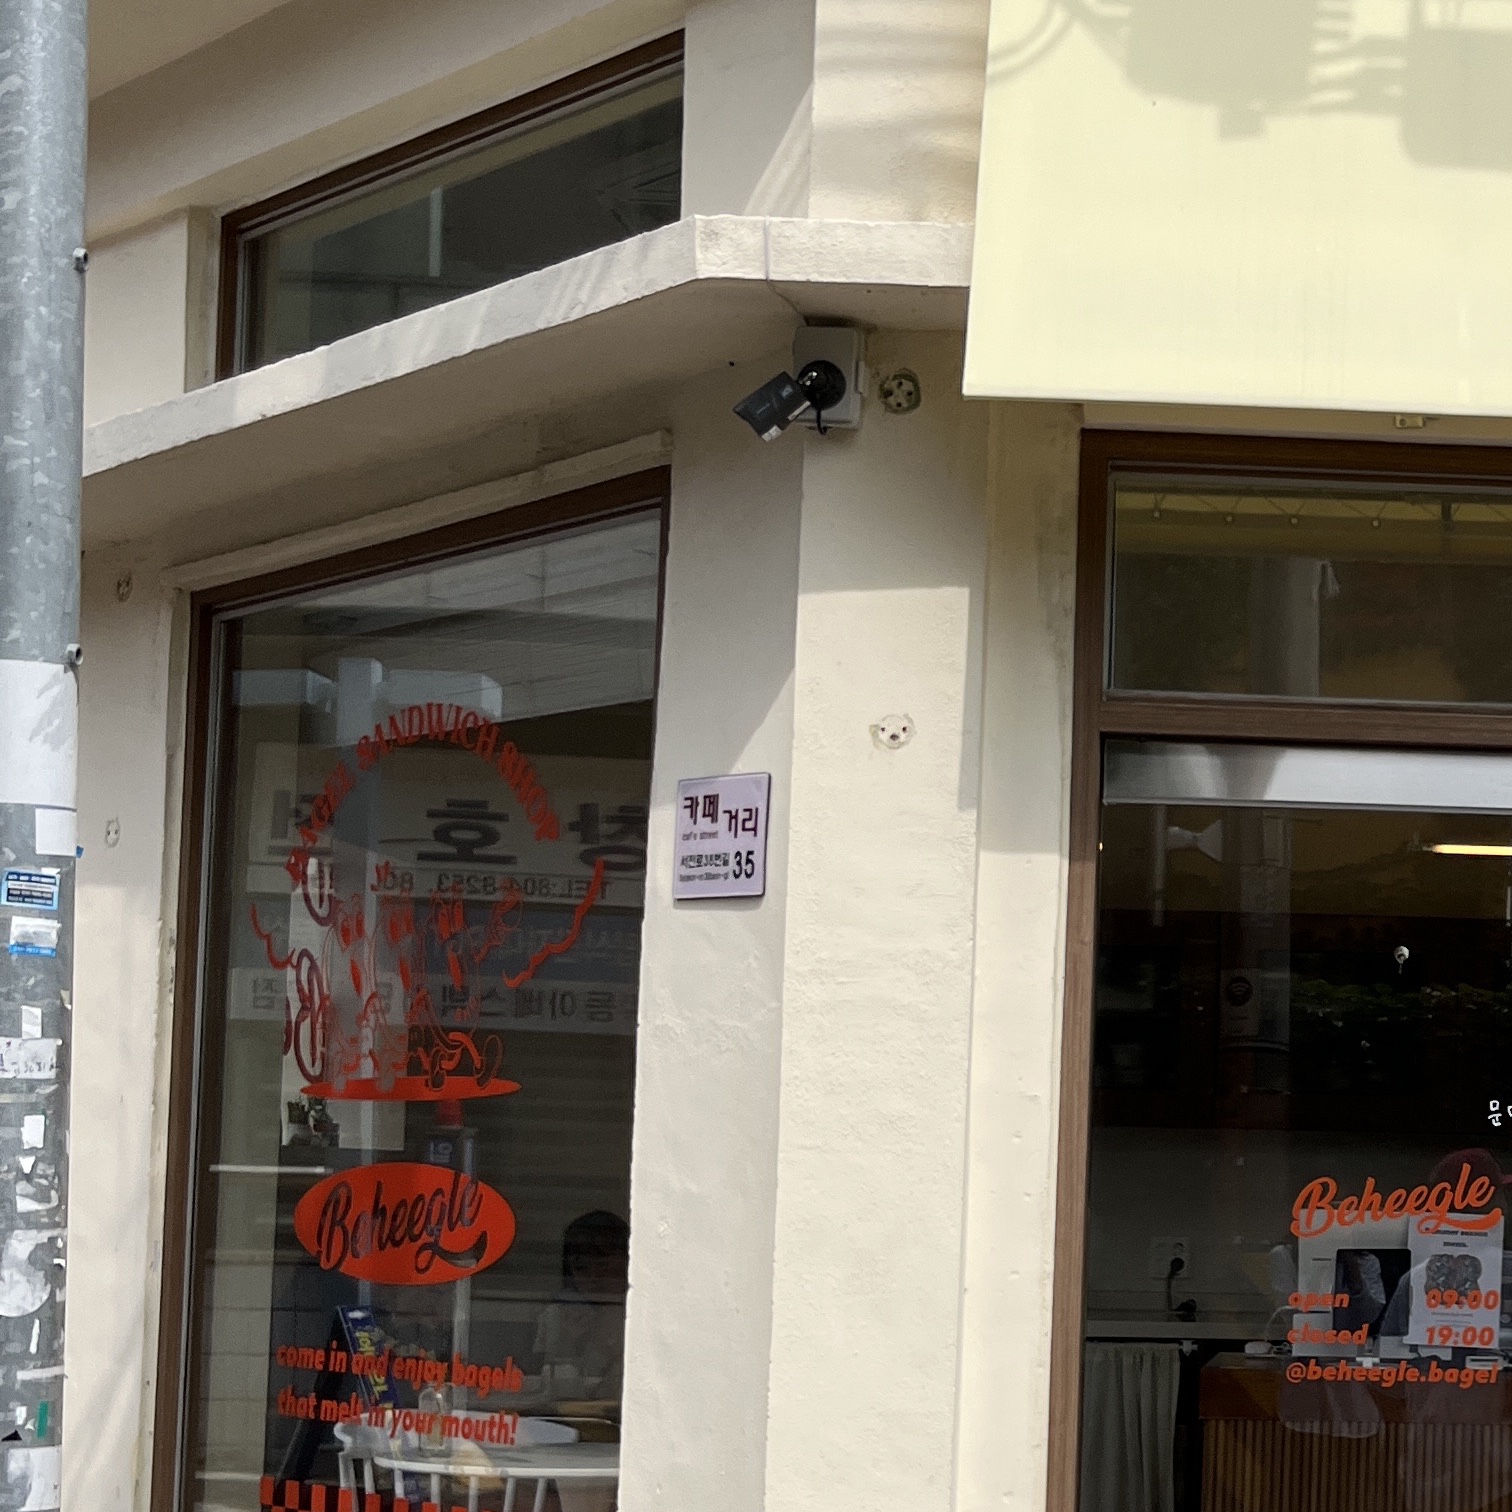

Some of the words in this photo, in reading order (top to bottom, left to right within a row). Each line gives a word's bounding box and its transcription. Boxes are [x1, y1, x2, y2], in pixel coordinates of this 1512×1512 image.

[355, 702, 500, 772] SANDWICH
[683, 793, 719, 825] 카페
[722, 807, 759, 839] 거리
[732, 850, 755, 879] 35
[1487, 1099, 1502, 1127] 문
[317, 1170, 489, 1274] Beheegle
[1289, 1163, 1503, 1239] Beheegle
[1287, 1291, 1350, 1312] open
[1426, 1288, 1500, 1310] 09:00
[1286, 1323, 1369, 1346] closed
[1426, 1325, 1494, 1347] 19:00
[275, 1343, 326, 1372] come
[328, 1341, 348, 1374] in
[350, 1343, 390, 1378] and
[391, 1346, 449, 1392] enjoy
[449, 1355, 525, 1399] bagels
[1285, 1359, 1500, 1389] @beheegle.bagel
[276, 1385, 318, 1420] that
[319, 1391, 363, 1425] melt
[366, 1398, 388, 1429] in
[389, 1409, 440, 1438] your
[440, 1410, 520, 1446] mouth!
